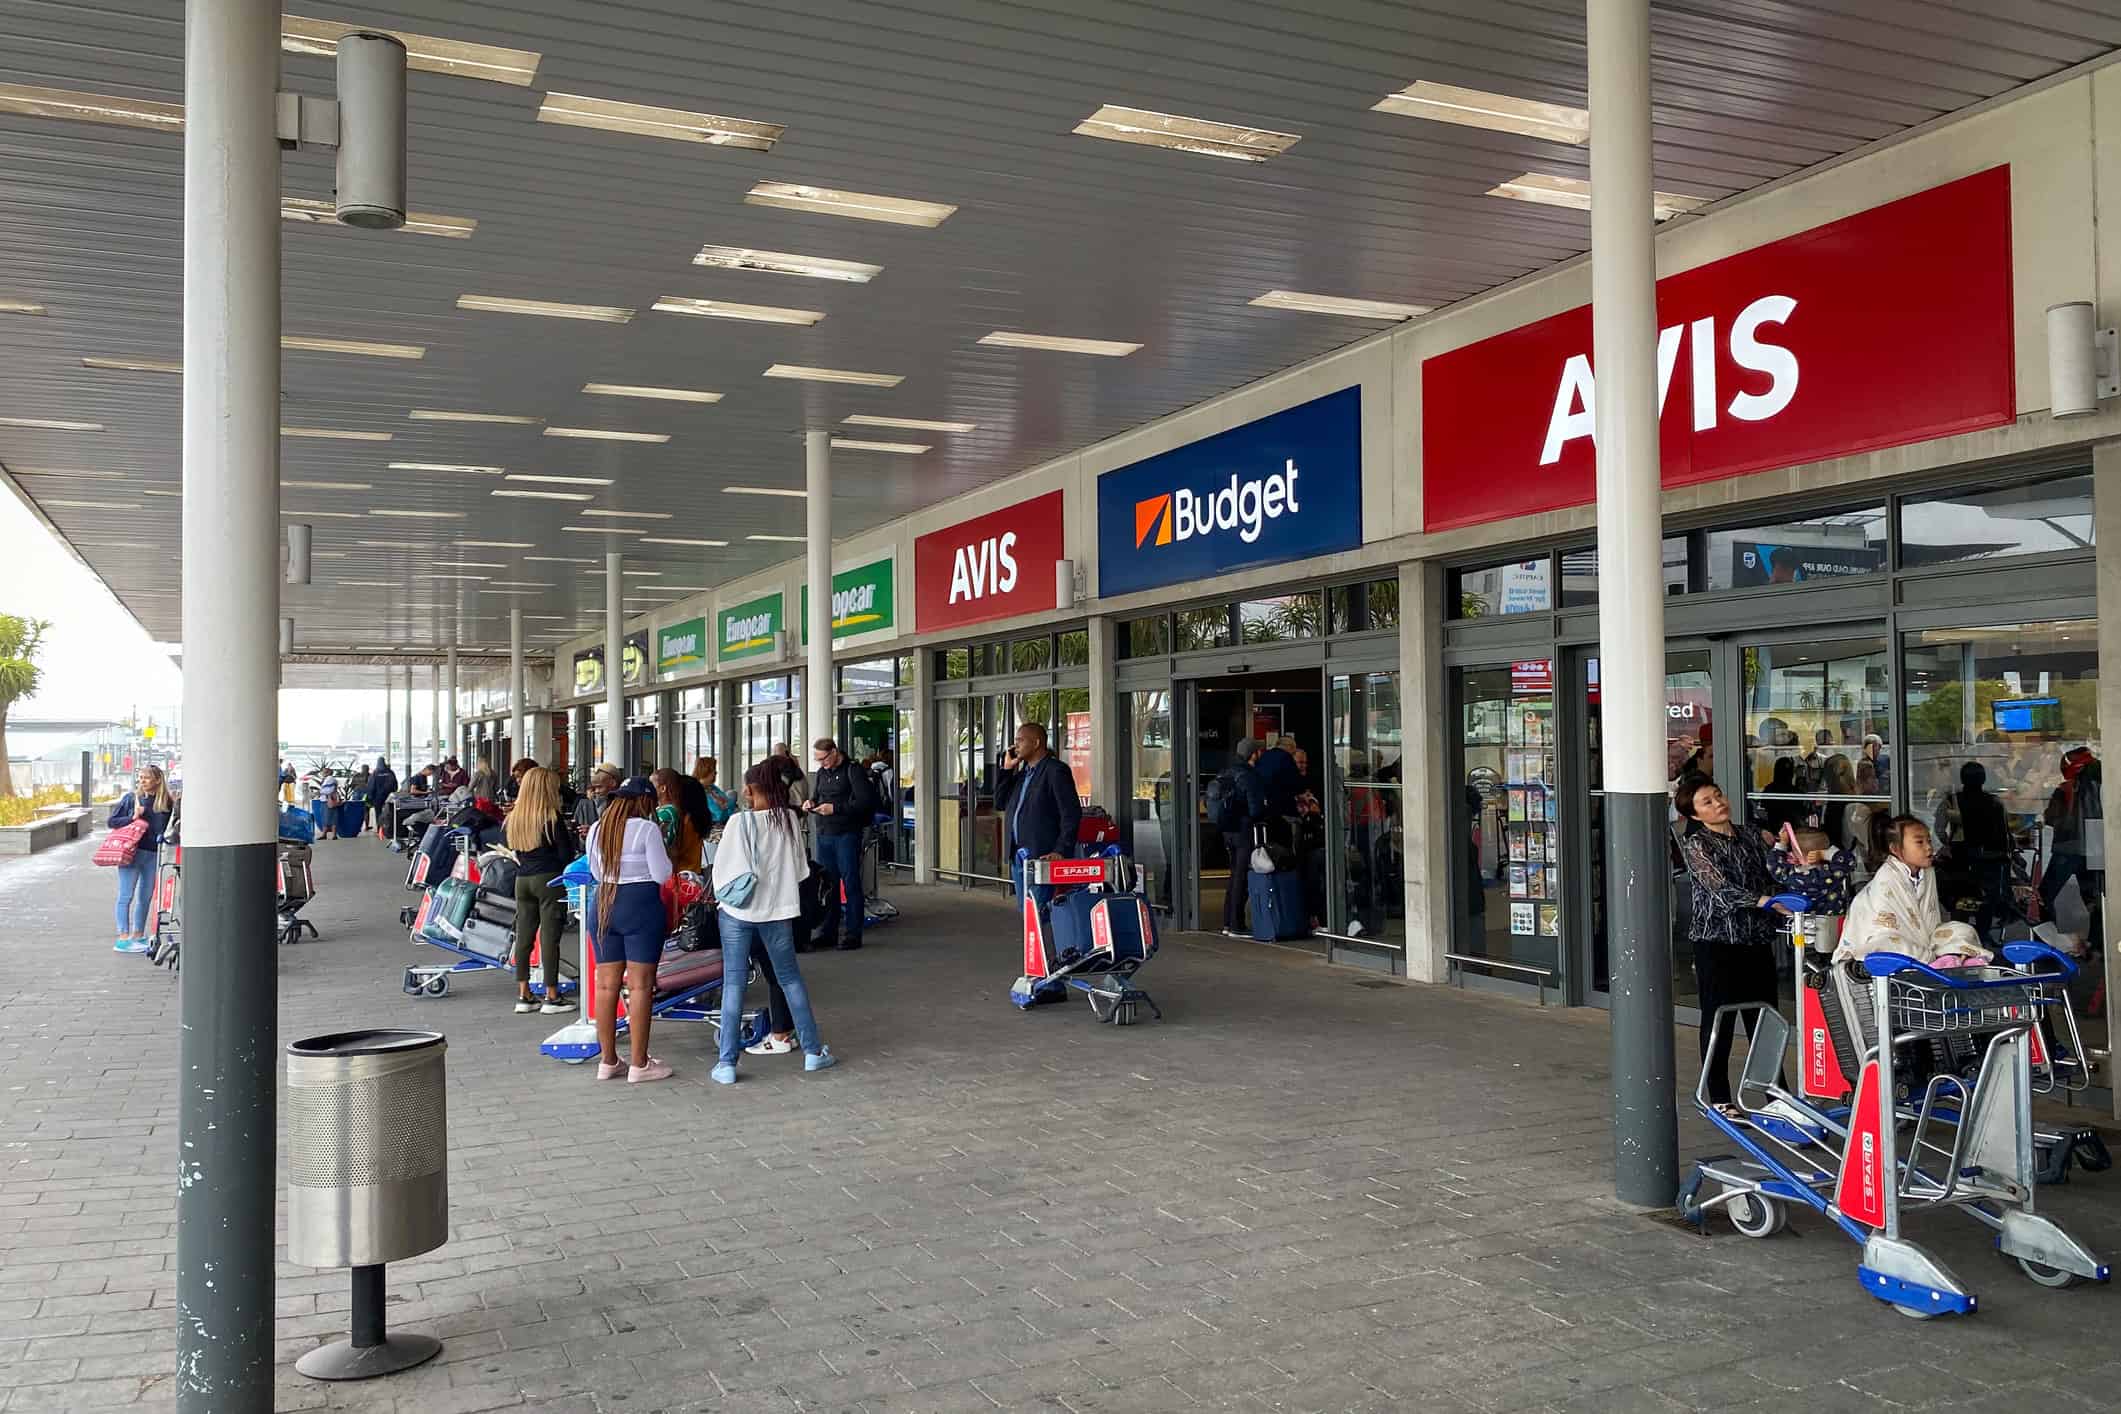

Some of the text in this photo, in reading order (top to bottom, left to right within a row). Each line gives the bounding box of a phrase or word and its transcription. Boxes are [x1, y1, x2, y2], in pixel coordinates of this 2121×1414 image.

[1175, 459, 1299, 543] Budget
[949, 531, 1018, 605] AVIS
[832, 584, 876, 625] opcar
[1063, 867, 1089, 876] SPAR
